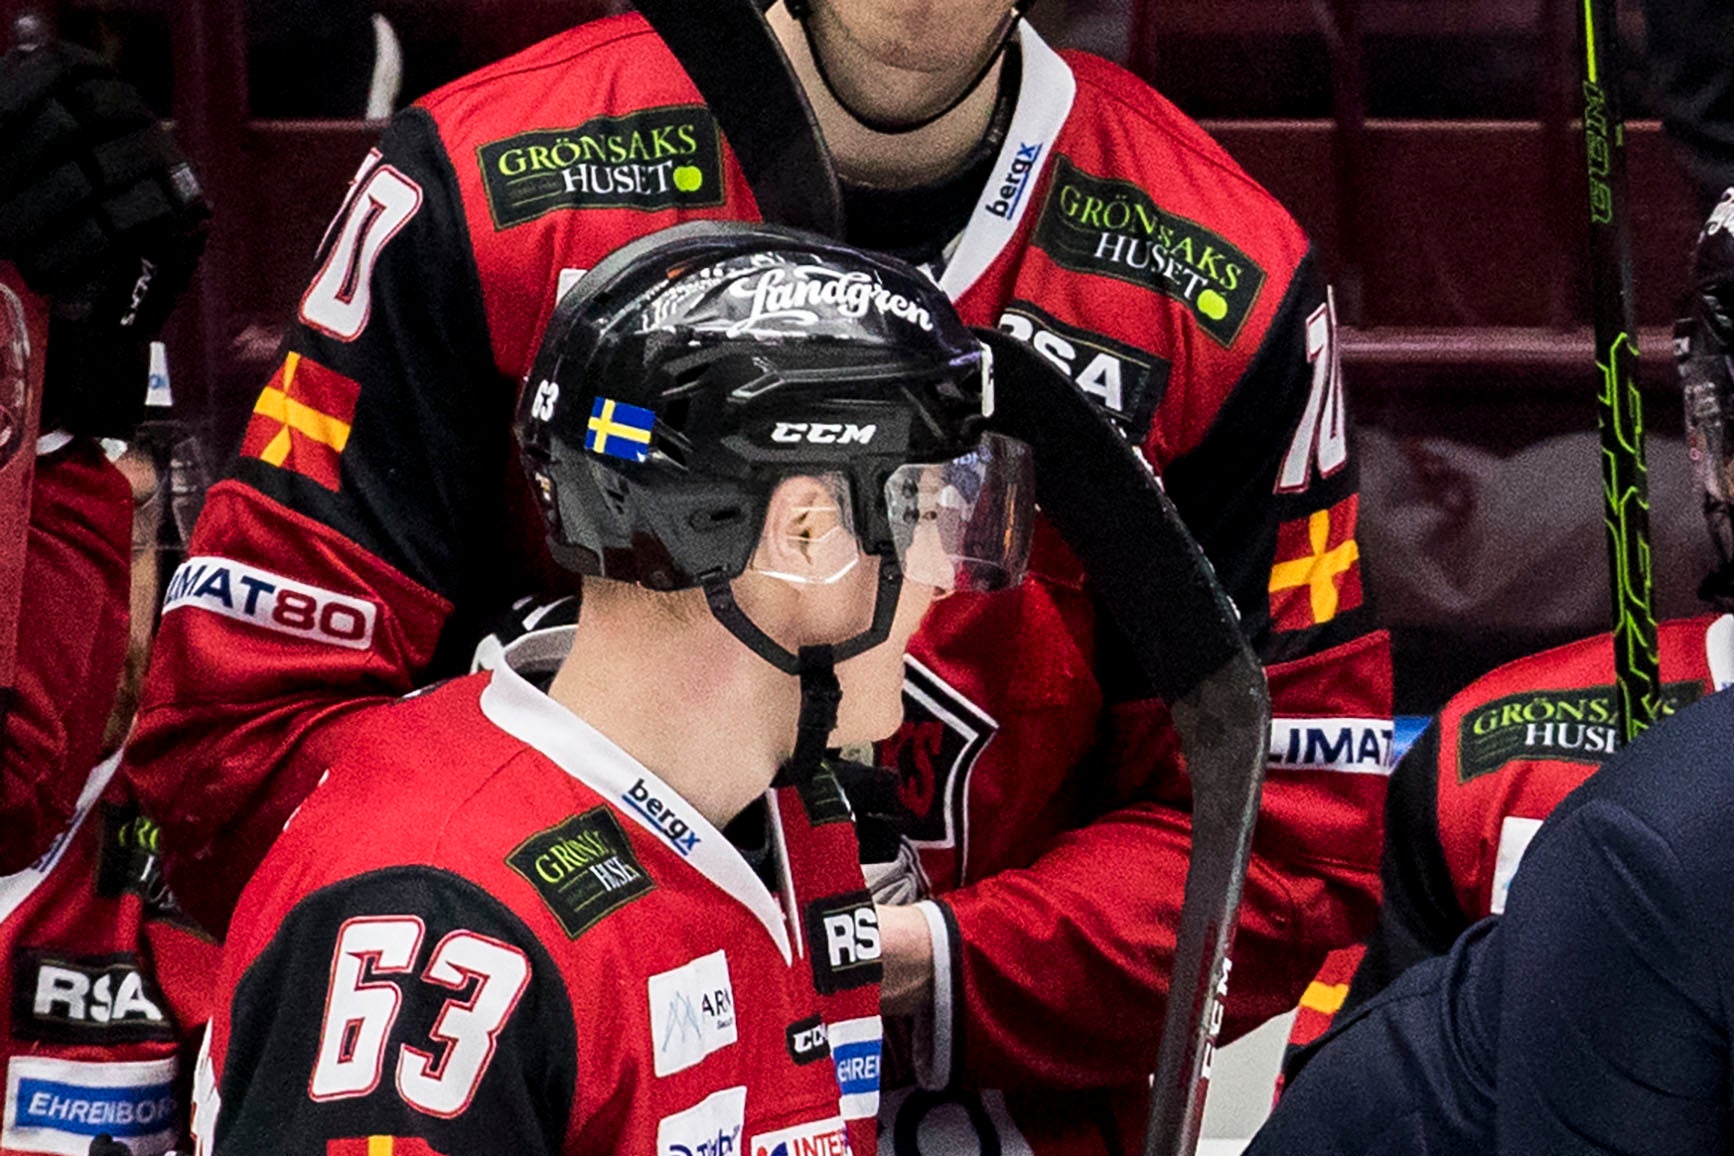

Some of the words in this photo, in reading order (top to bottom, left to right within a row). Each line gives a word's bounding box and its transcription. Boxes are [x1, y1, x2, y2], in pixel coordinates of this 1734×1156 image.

[498, 124, 697, 176] GRÖNSAKS
[562, 161, 672, 196] HUSET
[985, 143, 1042, 220] bergx
[299, 147, 424, 342] 0
[1060, 185, 1243, 291] GRÖNSAKS
[1094, 232, 1210, 299] HUSET
[727, 264, 934, 340] Landgren
[771, 421, 877, 444] CCM
[622, 779, 701, 856] bergx
[823, 912, 881, 967] RS
[33, 965, 164, 1023] RSA
[309, 915, 533, 1121] 63
[793, 1024, 830, 1053] CC
